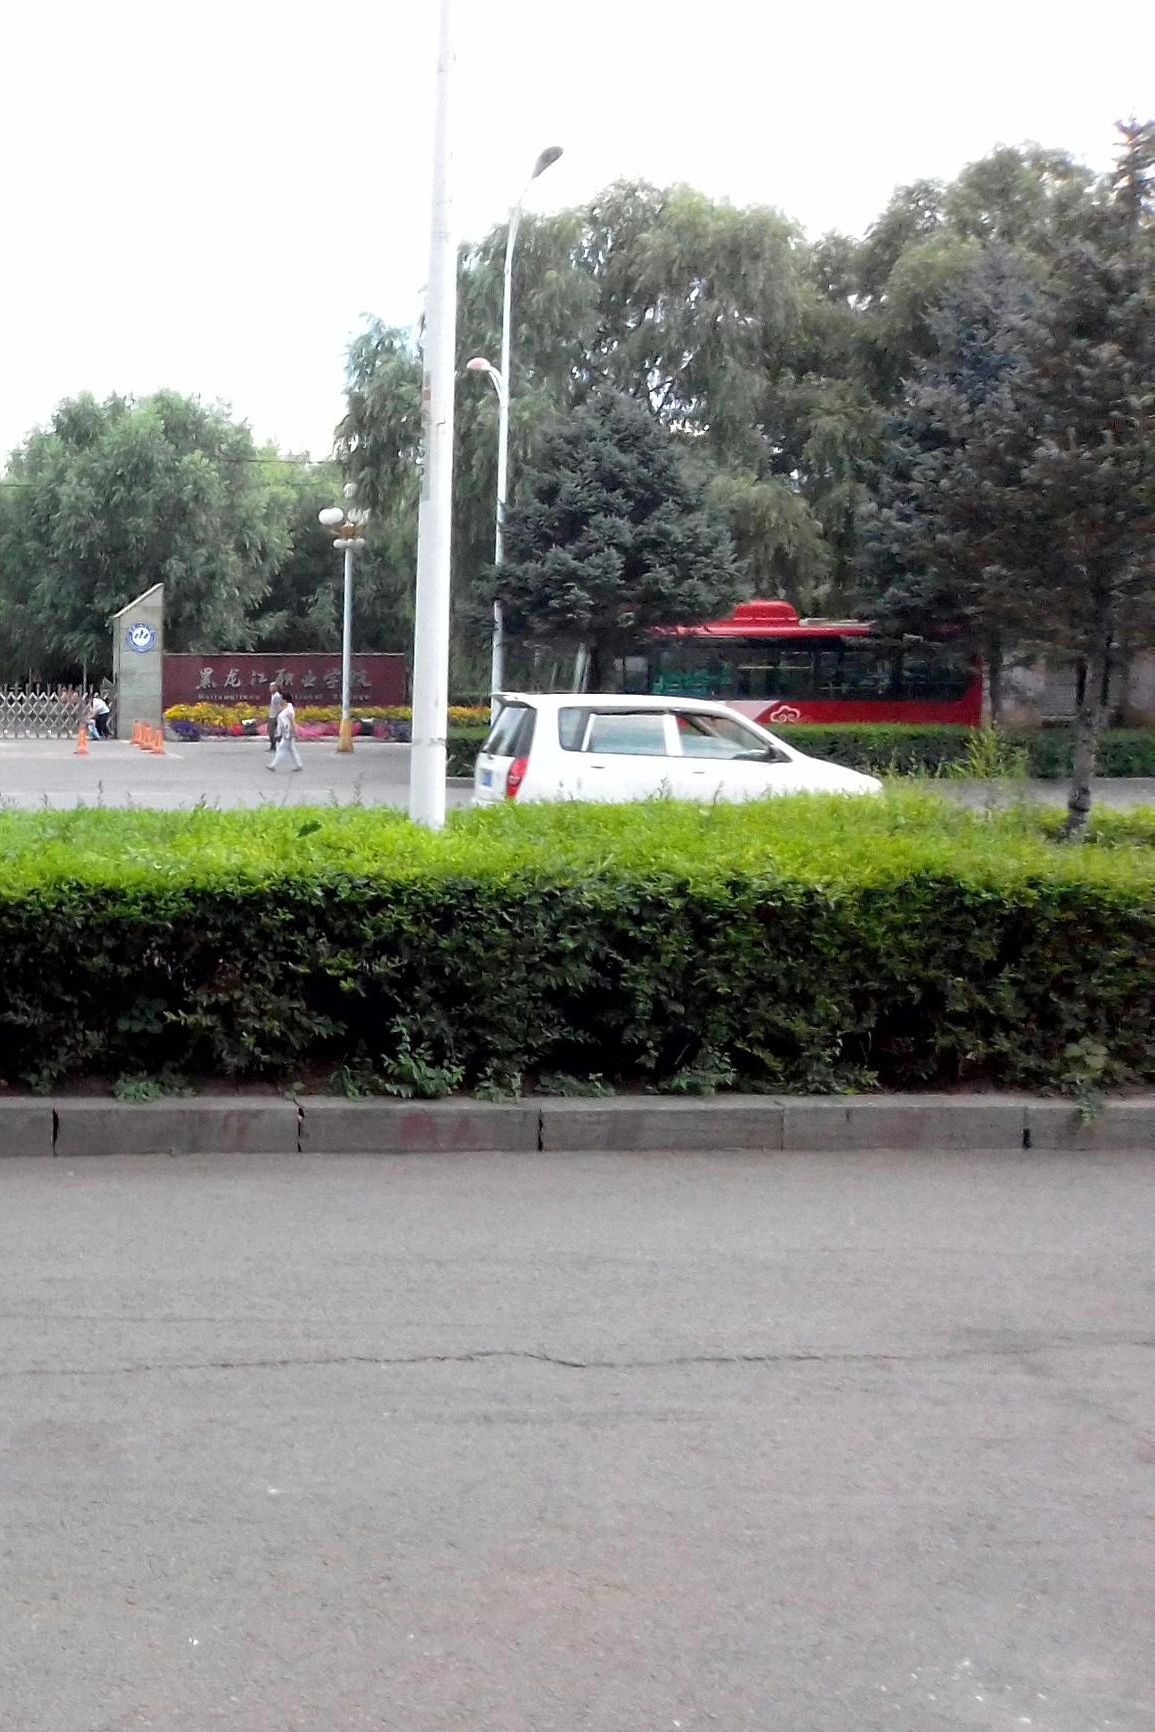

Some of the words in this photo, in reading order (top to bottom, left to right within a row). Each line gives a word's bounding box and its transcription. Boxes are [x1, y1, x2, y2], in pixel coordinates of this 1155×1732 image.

[196, 667, 372, 689] 黑龙江职业学院
